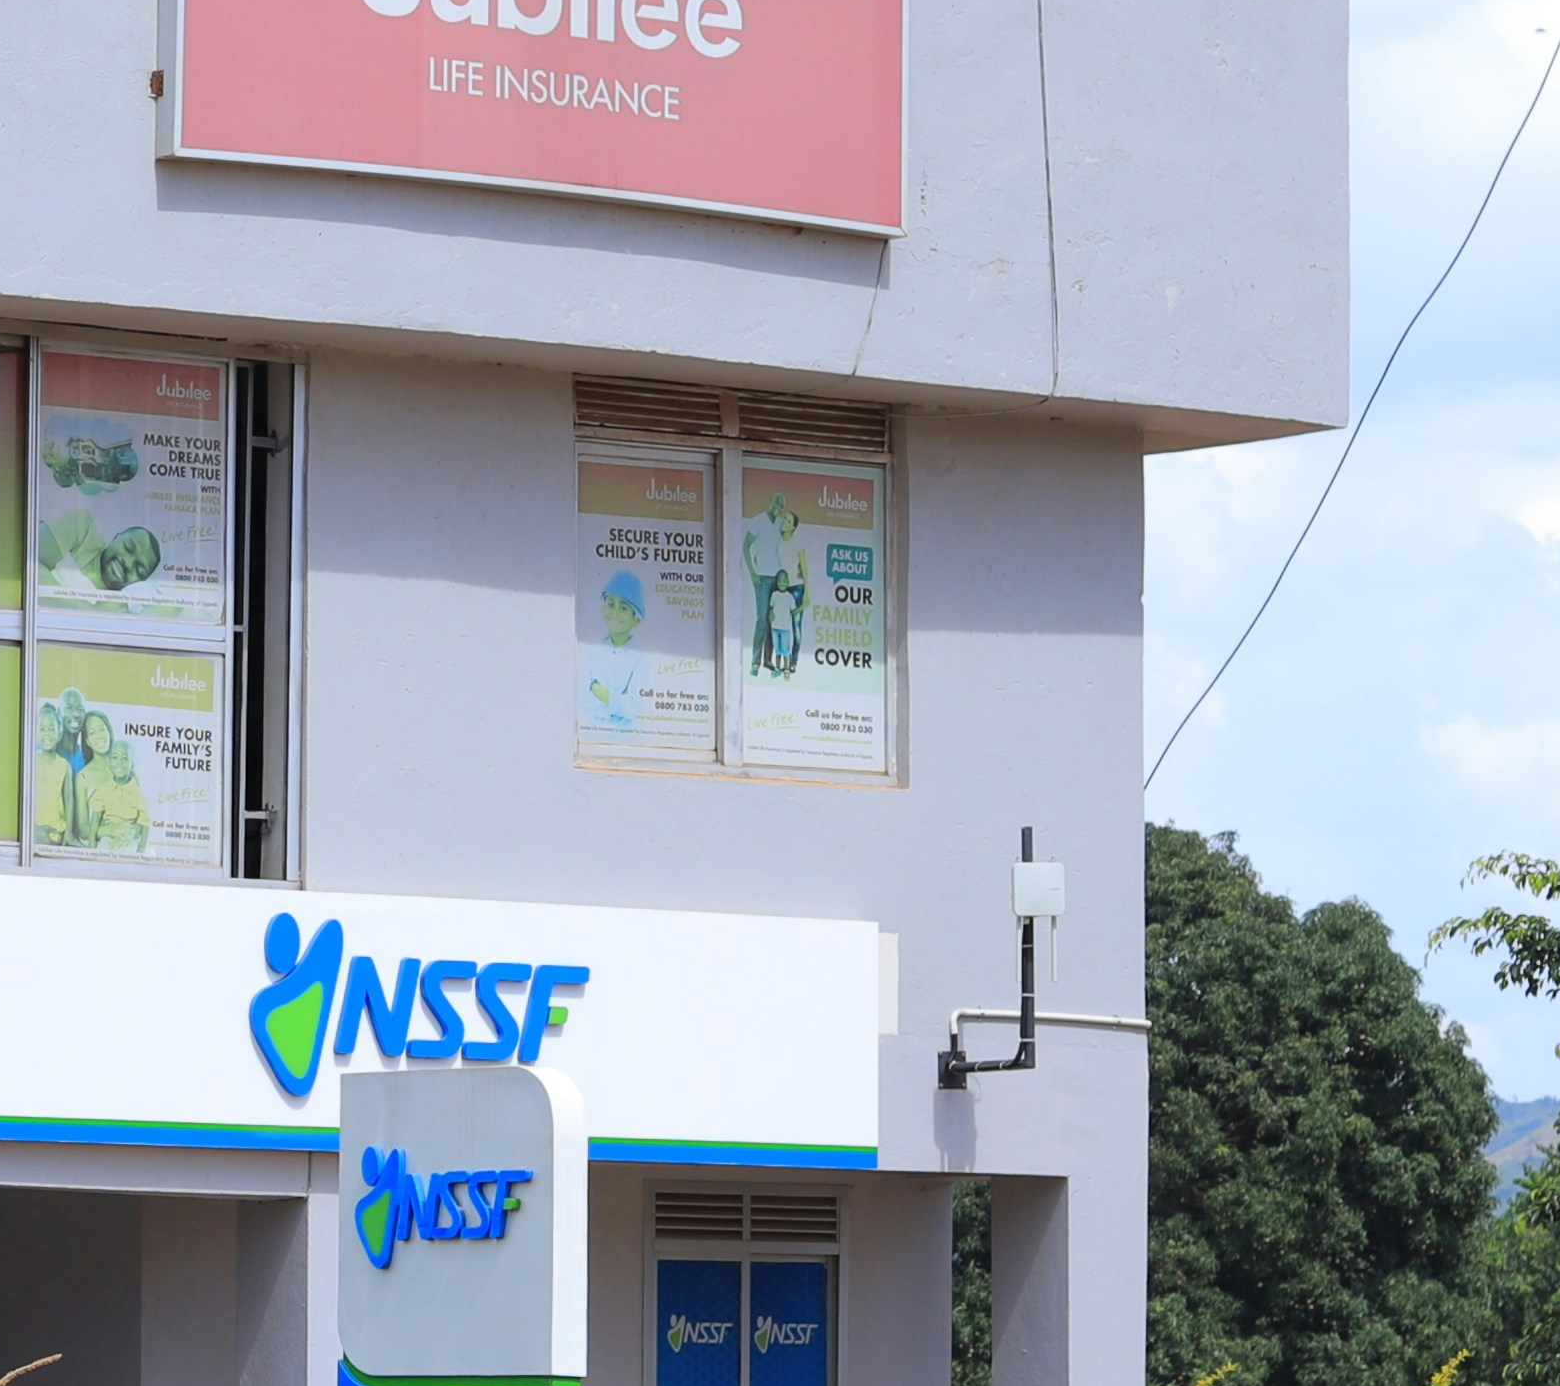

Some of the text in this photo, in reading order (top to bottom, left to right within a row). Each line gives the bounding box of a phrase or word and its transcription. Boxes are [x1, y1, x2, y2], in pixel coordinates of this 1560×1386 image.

[428, 56, 680, 120] LIFE INSURANCE
[156, 373, 212, 401] Jubilee
[143, 433, 221, 452] MAKE YOUR
[169, 450, 221, 466] DREAMS
[149, 463, 221, 481] COME TRUE
[200, 485, 221, 494] WITH
[646, 477, 697, 503] Jubilee
[818, 485, 868, 512] Jubilee
[175, 494, 221, 505] INSURANCE
[609, 528, 704, 548] SECURE YOUR
[654, 548, 704, 564] FUTURE
[831, 548, 869, 563] ASK US
[660, 571, 704, 583] WITH OUR
[832, 562, 868, 575] ABOUT
[655, 584, 705, 595] EDUCATION
[834, 586, 873, 605] OUR
[666, 597, 705, 607] SAVINGS
[682, 609, 705, 620] PLAN
[812, 605, 873, 626] FAMILY
[815, 626, 873, 647] SHIELD
[814, 648, 873, 670] COVER
[150, 665, 207, 693] Jubilee
[639, 688, 654, 698] Call
[667, 690, 678, 699] for
[680, 691, 695, 700] free
[655, 701, 710, 713] 0800 783 030
[805, 709, 820, 718] Call
[821, 712, 830, 720] us
[832, 711, 843, 720] for
[844, 712, 859, 721] free
[125, 723, 212, 743] INSURE YOUR
[820, 722, 873, 734] 0800 783 030
[165, 757, 211, 772] FUTURE
[153, 820, 165, 828] Call
[334, 955, 591, 1062] NSSF
[396, 1169, 534, 1241] NSSF
[683, 1322, 734, 1344] NSSF
[770, 1323, 819, 1345] NSSF
